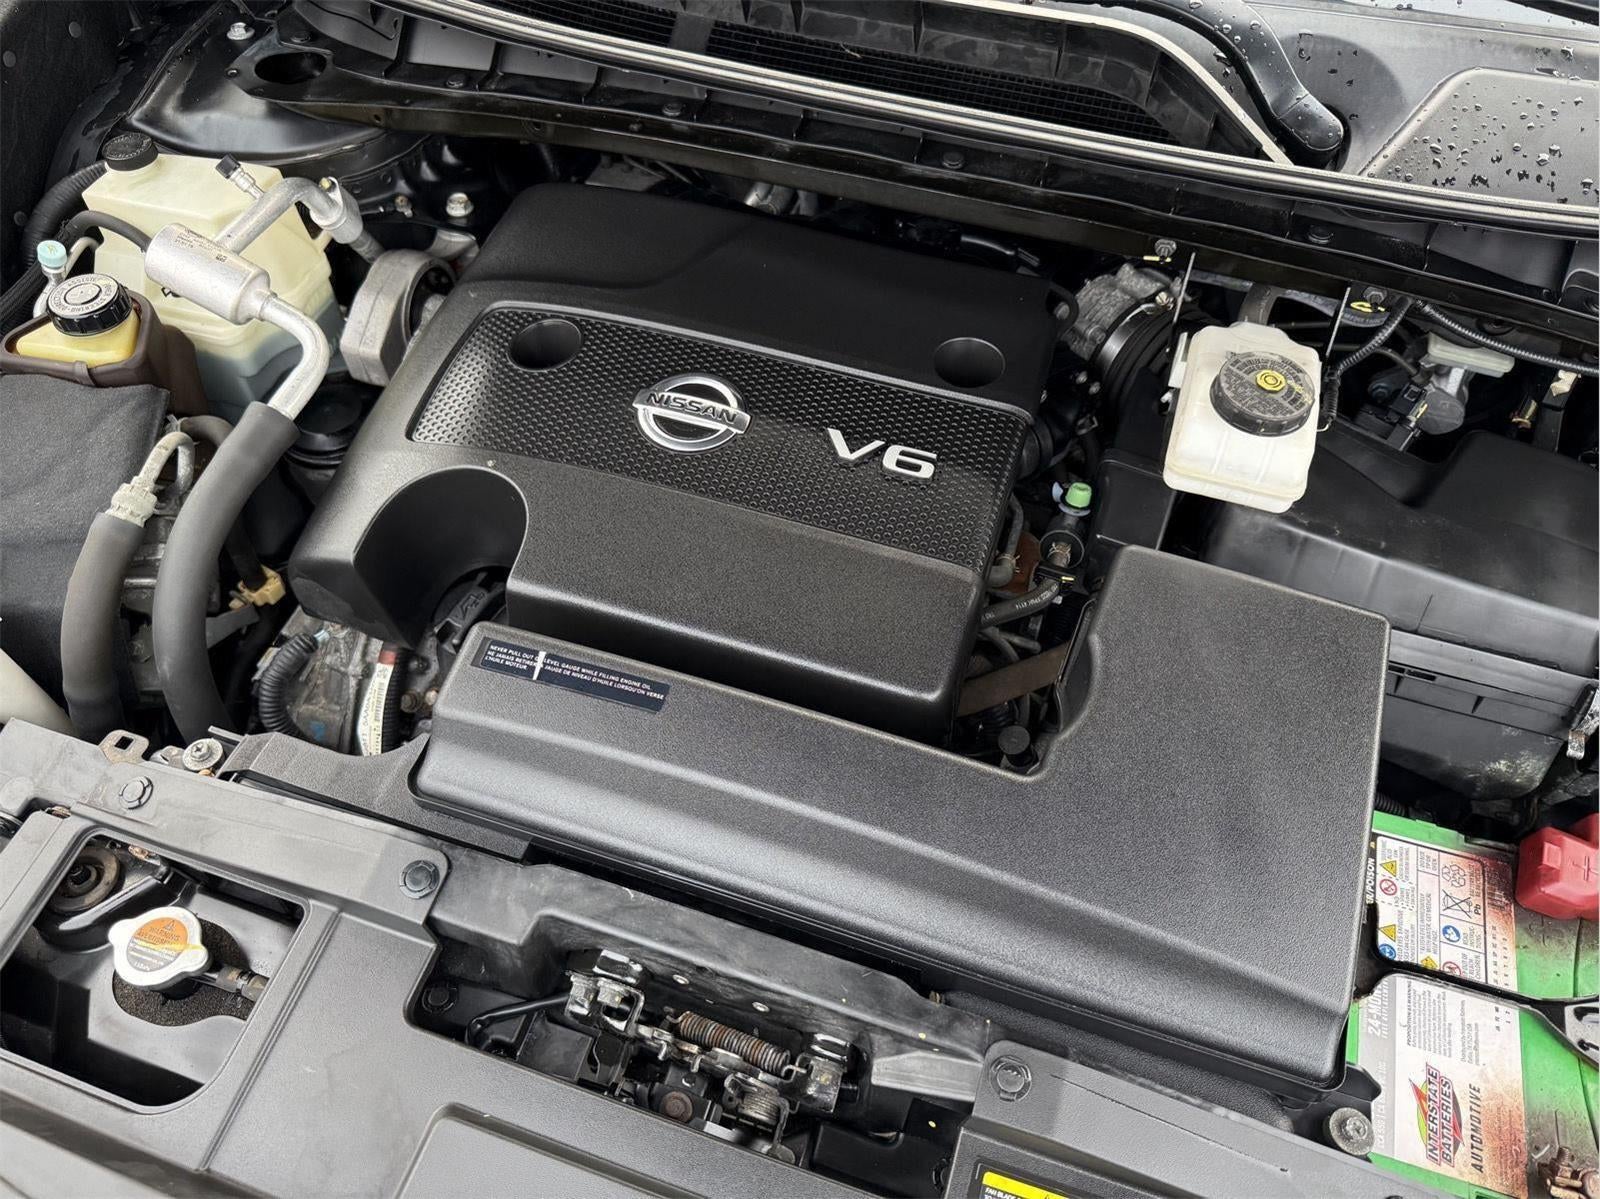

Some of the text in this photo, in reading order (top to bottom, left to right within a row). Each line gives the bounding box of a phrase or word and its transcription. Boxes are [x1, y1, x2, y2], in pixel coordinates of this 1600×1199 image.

[650, 392, 737, 423] NISSAN
[827, 428, 937, 480] V6
[489, 644, 507, 653] NEVER
[507, 648, 521, 657] PULL
[521, 652, 533, 660] OUT
[560, 662, 580, 671] GAUGE
[580, 667, 598, 676] WHILE
[597, 671, 620, 682] FILLING
[619, 677, 641, 687] ENGINE
[495, 651, 514, 661] JAMAIS
[544, 664, 562, 673] JAUGE
[570, 671, 591, 681] NIVEAU
[591, 676, 614, 686] D'HUILE
[646, 688, 665, 700] VERSE
[504, 659, 527, 670] MOTEUR
[1473, 902, 1481, 915] Pb
[1427, 1067, 1440, 1164] INTERSTATE
[1441, 1078, 1453, 1164] BATTERIES
[1469, 1083, 1485, 1174] AUTOMOTIVE
